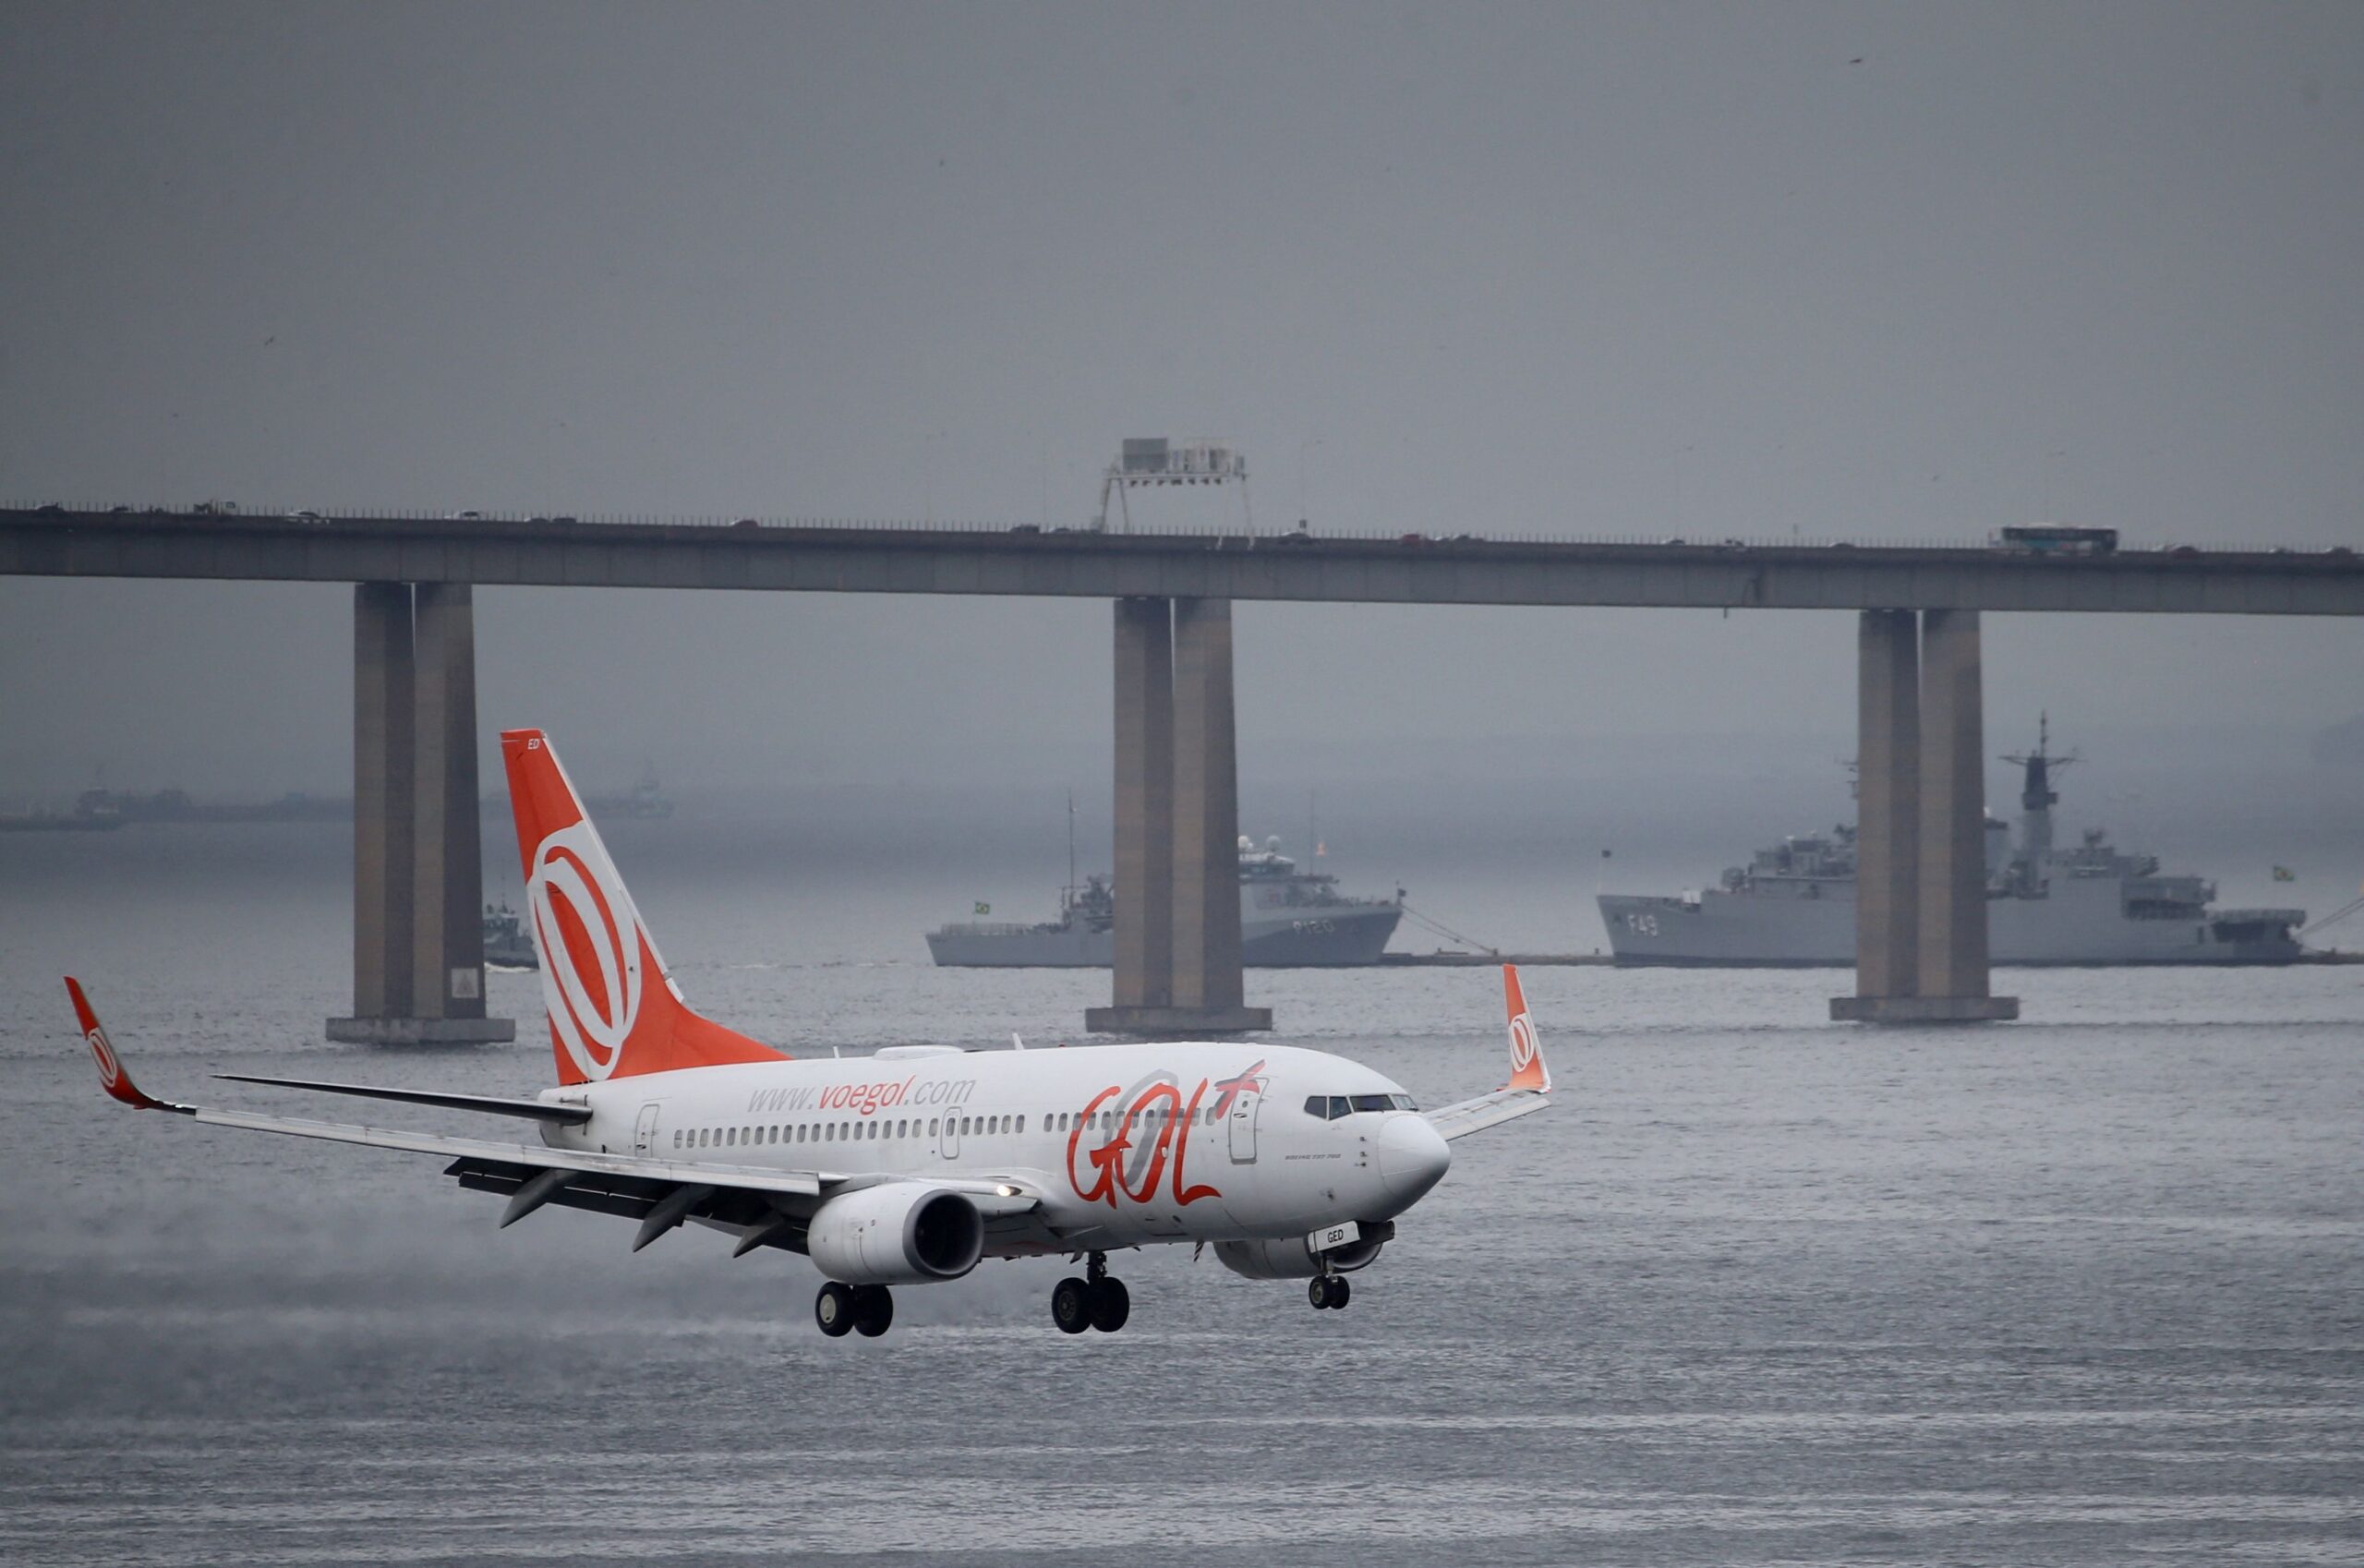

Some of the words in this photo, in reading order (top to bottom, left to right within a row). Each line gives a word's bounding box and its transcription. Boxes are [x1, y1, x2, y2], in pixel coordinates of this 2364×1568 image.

[527, 738, 540, 750] ED
[747, 1074, 977, 1116] www.voegol.com
[1066, 1077, 1223, 1210] GOL
[1327, 1228, 1344, 1243] GED
